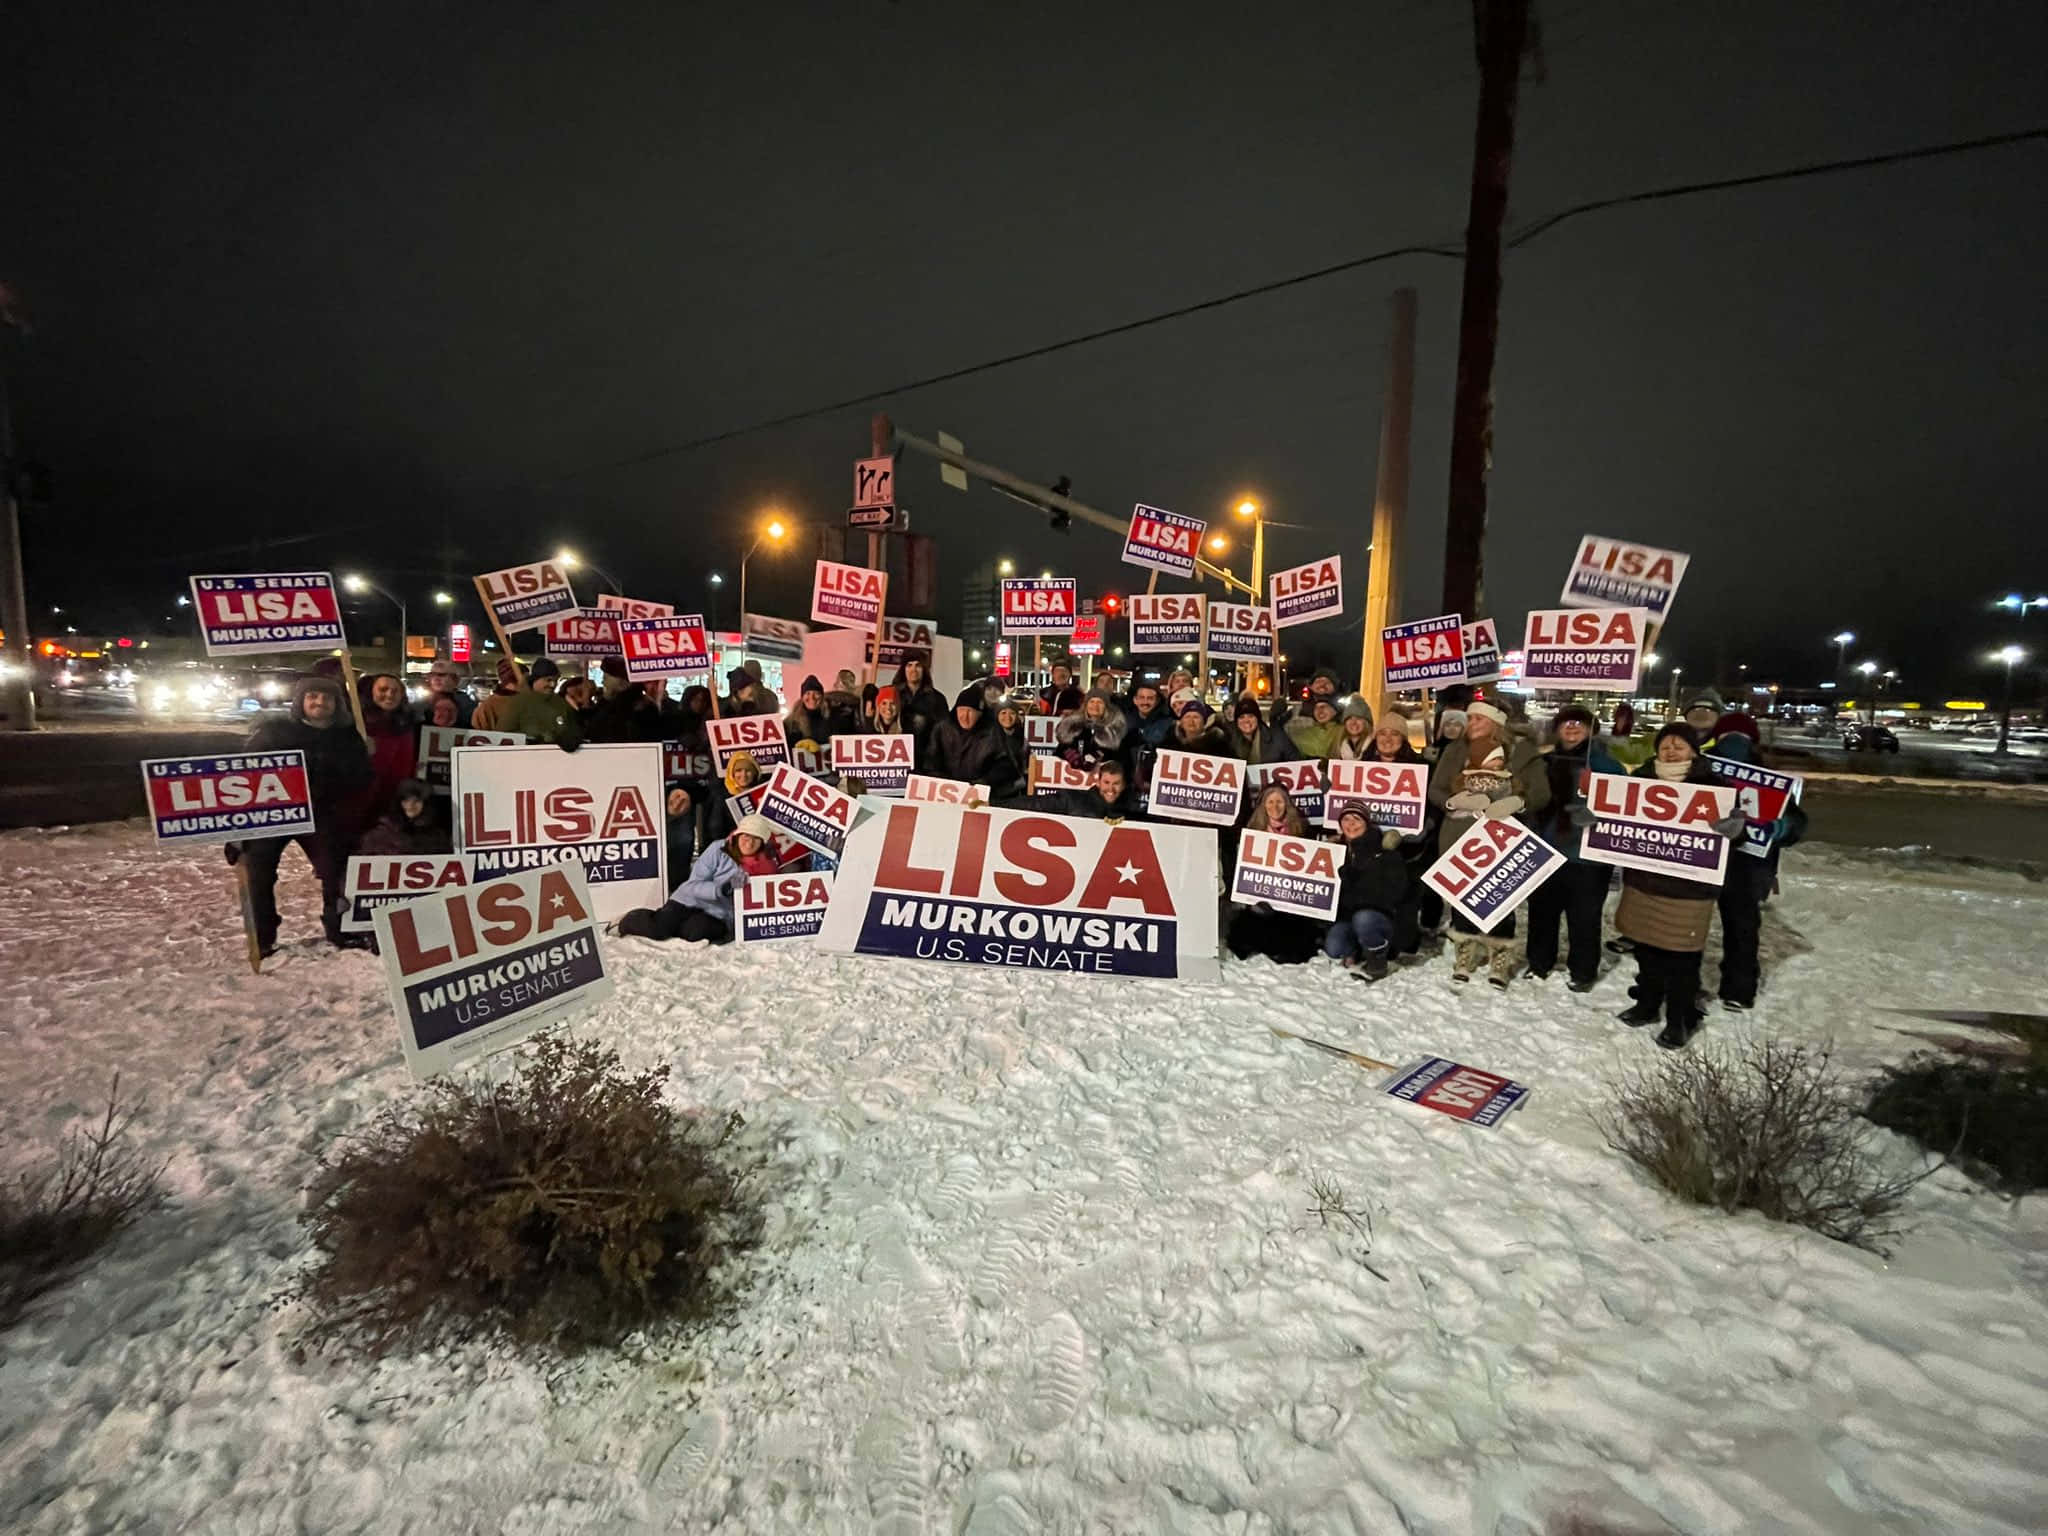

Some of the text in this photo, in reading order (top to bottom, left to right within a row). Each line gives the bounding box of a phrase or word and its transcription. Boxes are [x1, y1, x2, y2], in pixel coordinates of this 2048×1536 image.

[1139, 507, 1202, 531] U.S. SENATE
[1137, 521, 1189, 552] LISA
[1129, 543, 1193, 567] MURKOWSKI
[1581, 543, 1674, 584] LISA
[200, 577, 327, 590] U.S. SENATE
[481, 565, 564, 600] LISA
[820, 566, 880, 598] LISA
[1276, 563, 1336, 597] LISA
[214, 592, 322, 623] LISA
[496, 591, 567, 615] MURKOWSKI
[821, 594, 877, 613] MURKOWSKI
[1011, 592, 1066, 612] LISA
[1134, 598, 1200, 620] LISA
[1279, 588, 1336, 609] MURKOWSKI
[556, 621, 615, 640] LISA
[623, 618, 699, 630] U.S. SENATE
[1006, 617, 1072, 625] MURKOWSKI
[1137, 626, 1199, 634] MURKOWSKI
[1210, 606, 1272, 632] LISA
[1385, 619, 1457, 639] U.S. SENATE
[1530, 613, 1636, 645] LISA
[211, 624, 338, 642] MURKOWSKI
[631, 631, 697, 656] LISA
[1211, 634, 1270, 647] MURKOWSKI
[1463, 625, 1495, 653] SA
[550, 643, 621, 653] MURKOWSKI
[1392, 634, 1452, 665] LISA
[1465, 654, 1496, 667] OWSKI
[1532, 653, 1629, 665] MURKOWSKI
[630, 657, 707, 671] MURKOWSKI
[1388, 662, 1462, 681] MURKOWSKI
[1544, 665, 1612, 676] U.S. SENATE
[713, 720, 782, 746] LISA
[722, 747, 783, 759] MOWSKI
[835, 739, 910, 763] LISA
[153, 755, 298, 776] U.S. SENATE
[671, 755, 711, 775] LIS
[839, 768, 908, 777] MURKOWSKI
[1035, 760, 1099, 787] LIS
[1160, 755, 1237, 788] LISA
[1711, 762, 1789, 790] SENATE
[866, 778, 897, 786] SENATE
[1259, 765, 1320, 791] ISA
[1332, 764, 1421, 798] LISA
[169, 773, 292, 811] LISA
[772, 768, 850, 826] LISA
[908, 778, 981, 805] LISA
[1161, 785, 1233, 803] MURKOWSKI
[1593, 779, 1722, 829] LISA
[464, 786, 657, 848] LISA
[768, 798, 839, 837] MURKOWSKI
[1187, 800, 1220, 810] SENATE
[1333, 800, 1416, 815] MOWSKI
[162, 807, 306, 834] MURKOWSKI
[792, 820, 824, 842] SENATE
[1370, 813, 1401, 824] ENATE
[1596, 822, 1715, 851] MURKOWSKI
[478, 842, 649, 870] MURKOWSKI
[873, 804, 1177, 916] LISA
[1242, 835, 1335, 878] LISA
[1433, 819, 1523, 897] LISA
[1610, 838, 1694, 862] U.S. SENATE
[357, 860, 467, 890] LISA
[588, 864, 625, 881] ATE
[1243, 871, 1330, 896] MURKOWSKI
[1467, 841, 1537, 908] MURKOWSKI
[1501, 859, 1537, 892] SENATE
[742, 878, 829, 911] LISA
[1274, 889, 1314, 904] SENATE
[388, 870, 589, 977] LISA
[748, 912, 824, 928] MURKOWSK
[780, 923, 818, 935] SENATE
[881, 899, 1159, 953] MURKOWSKI
[916, 936, 1113, 972] U.S. SENATE
[419, 936, 590, 1013] MURKOWSKI
[455, 998, 496, 1024] U.S.
[500, 967, 574, 1008] SENATE
[1428, 1070, 1500, 1109] LISA
